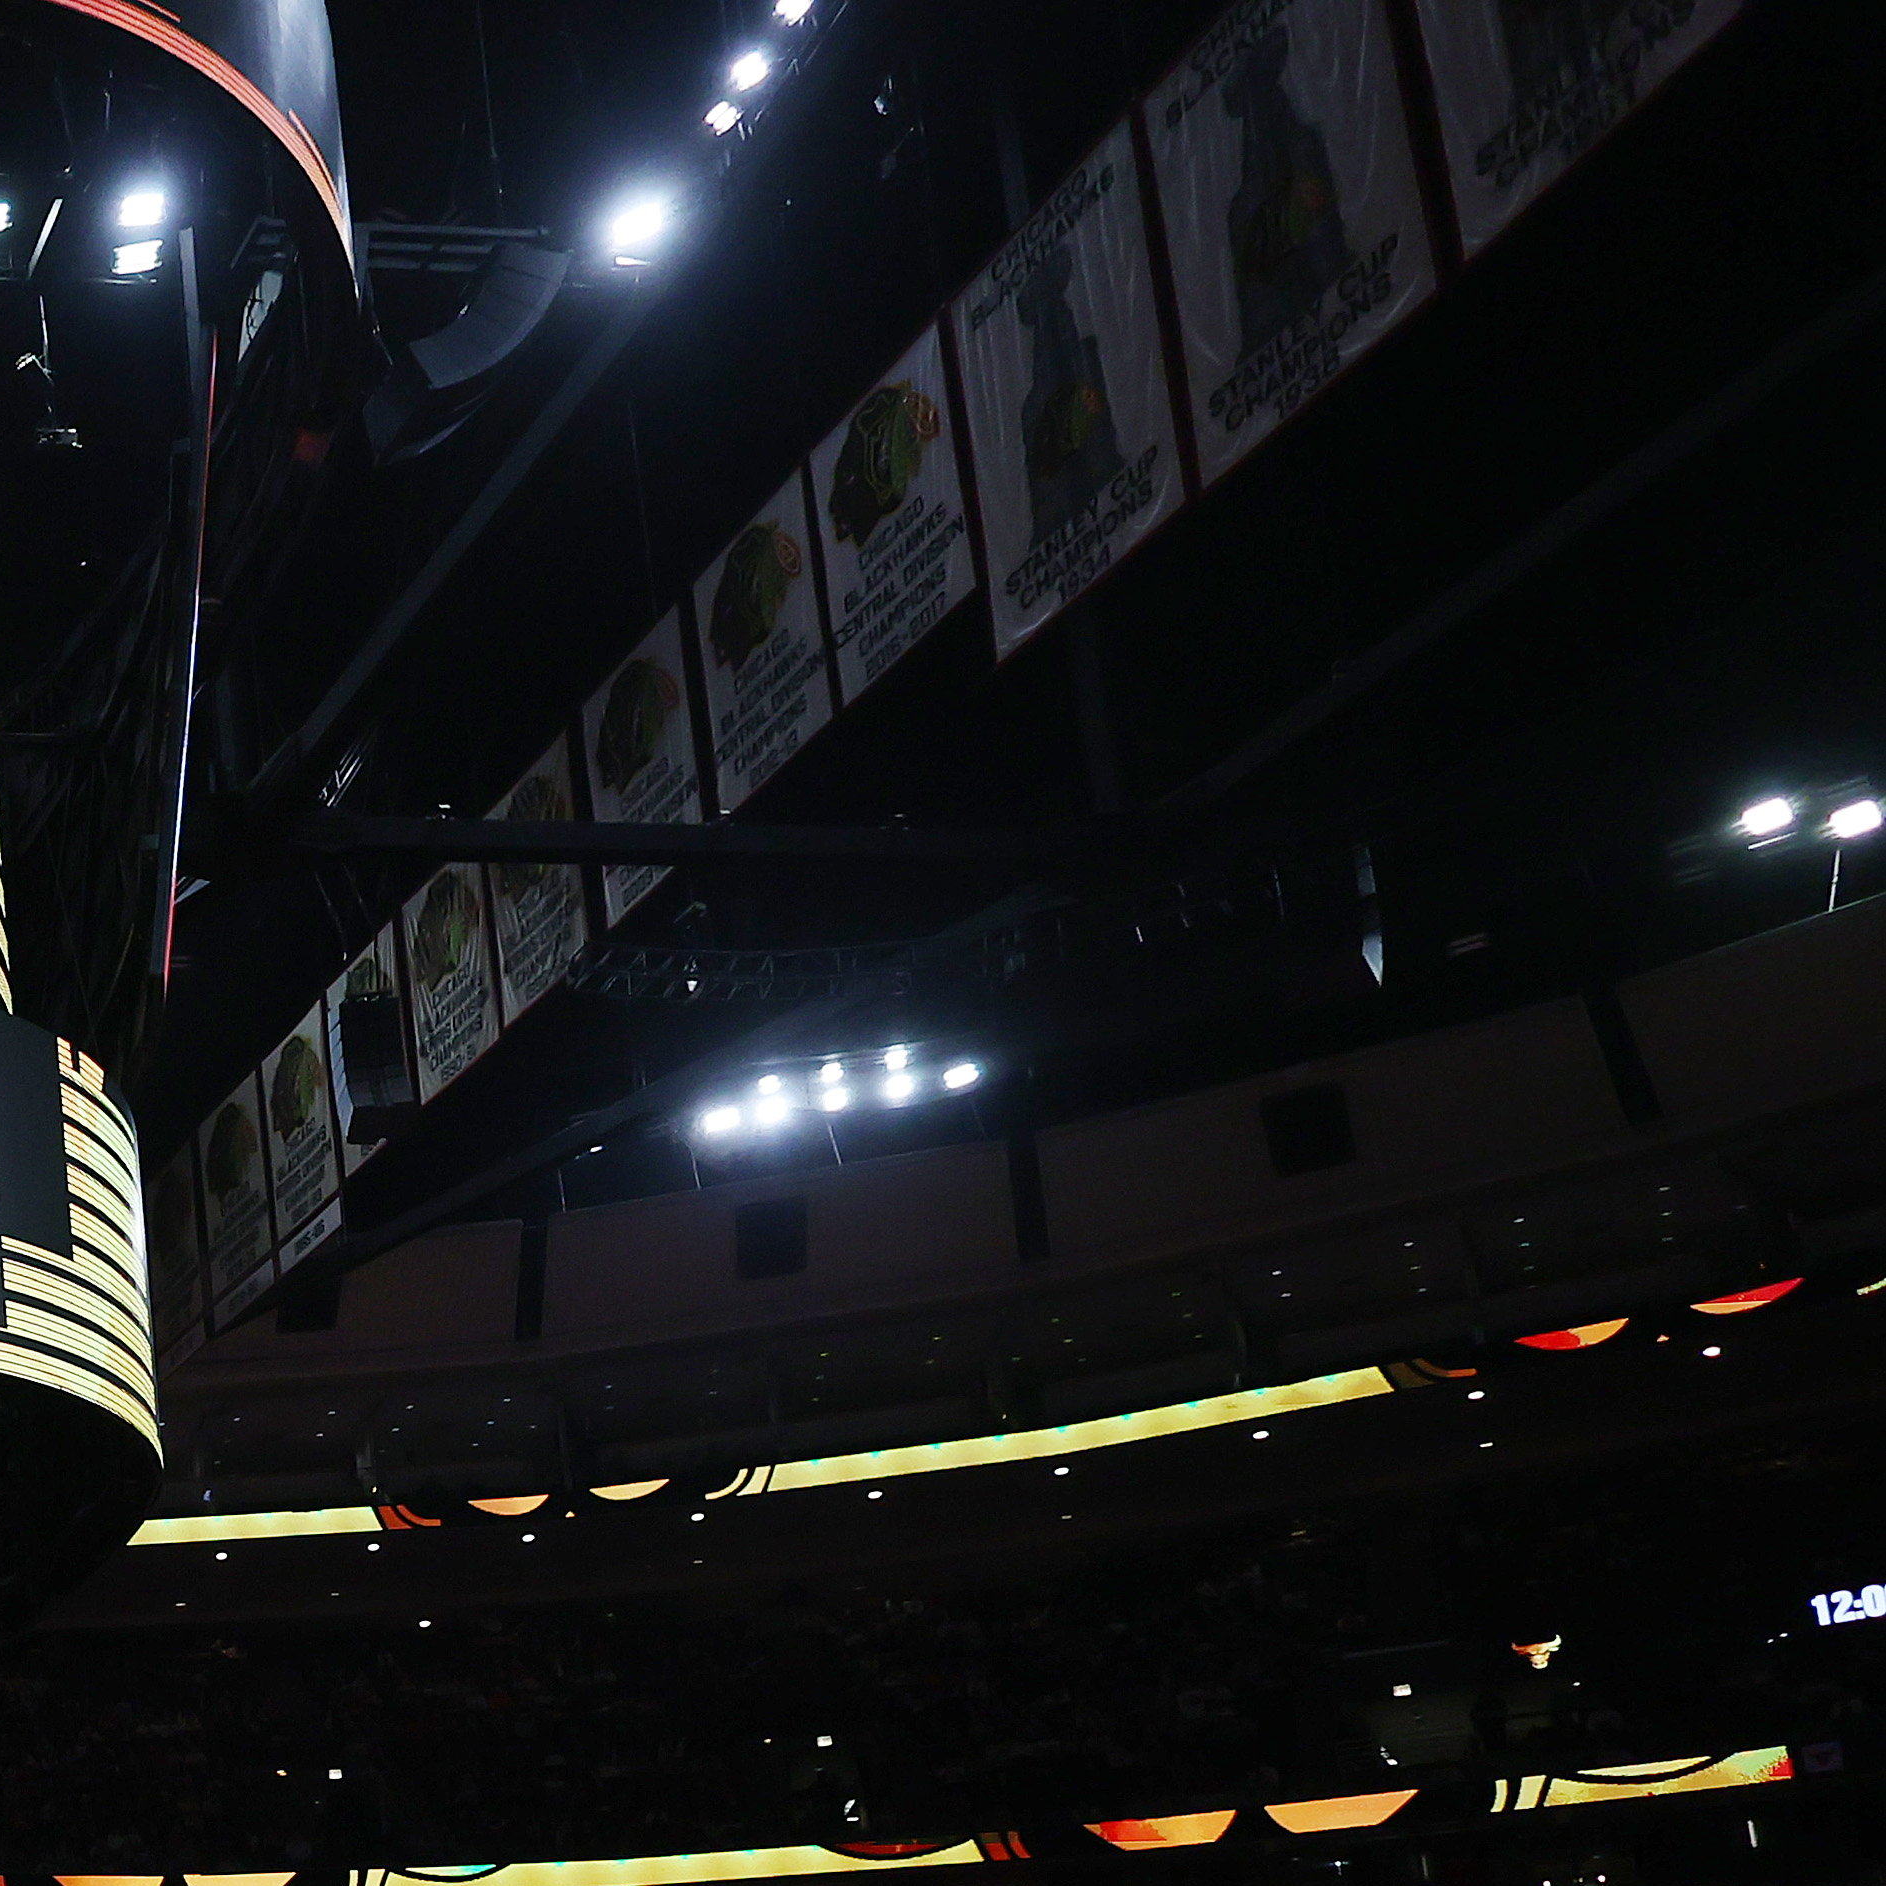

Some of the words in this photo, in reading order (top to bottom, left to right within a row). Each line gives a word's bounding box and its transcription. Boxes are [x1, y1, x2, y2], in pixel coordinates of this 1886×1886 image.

[970, 164, 1115, 332] BLACKHAWKS
[990, 168, 1089, 283] CHICAGO
[1209, 296, 1326, 418] STANLEY
[1338, 233, 1399, 302] CUP
[1225, 274, 1392, 433] CHAMPIONS
[832, 580, 897, 650] CENTRAL
[902, 512, 965, 587] DIVISION
[842, 502, 948, 615] BLACKHAWKS
[857, 495, 925, 573] CHICAGO
[1004, 497, 1101, 596] STANLEY
[1110, 444, 1159, 499] CUP
[1019, 479, 1154, 611] CHAMPIONS
[1054, 548, 1113, 605] 1934
[858, 561, 948, 658] CHAMPIONS
[1811, 1583, 1886, 1628] 12:0
